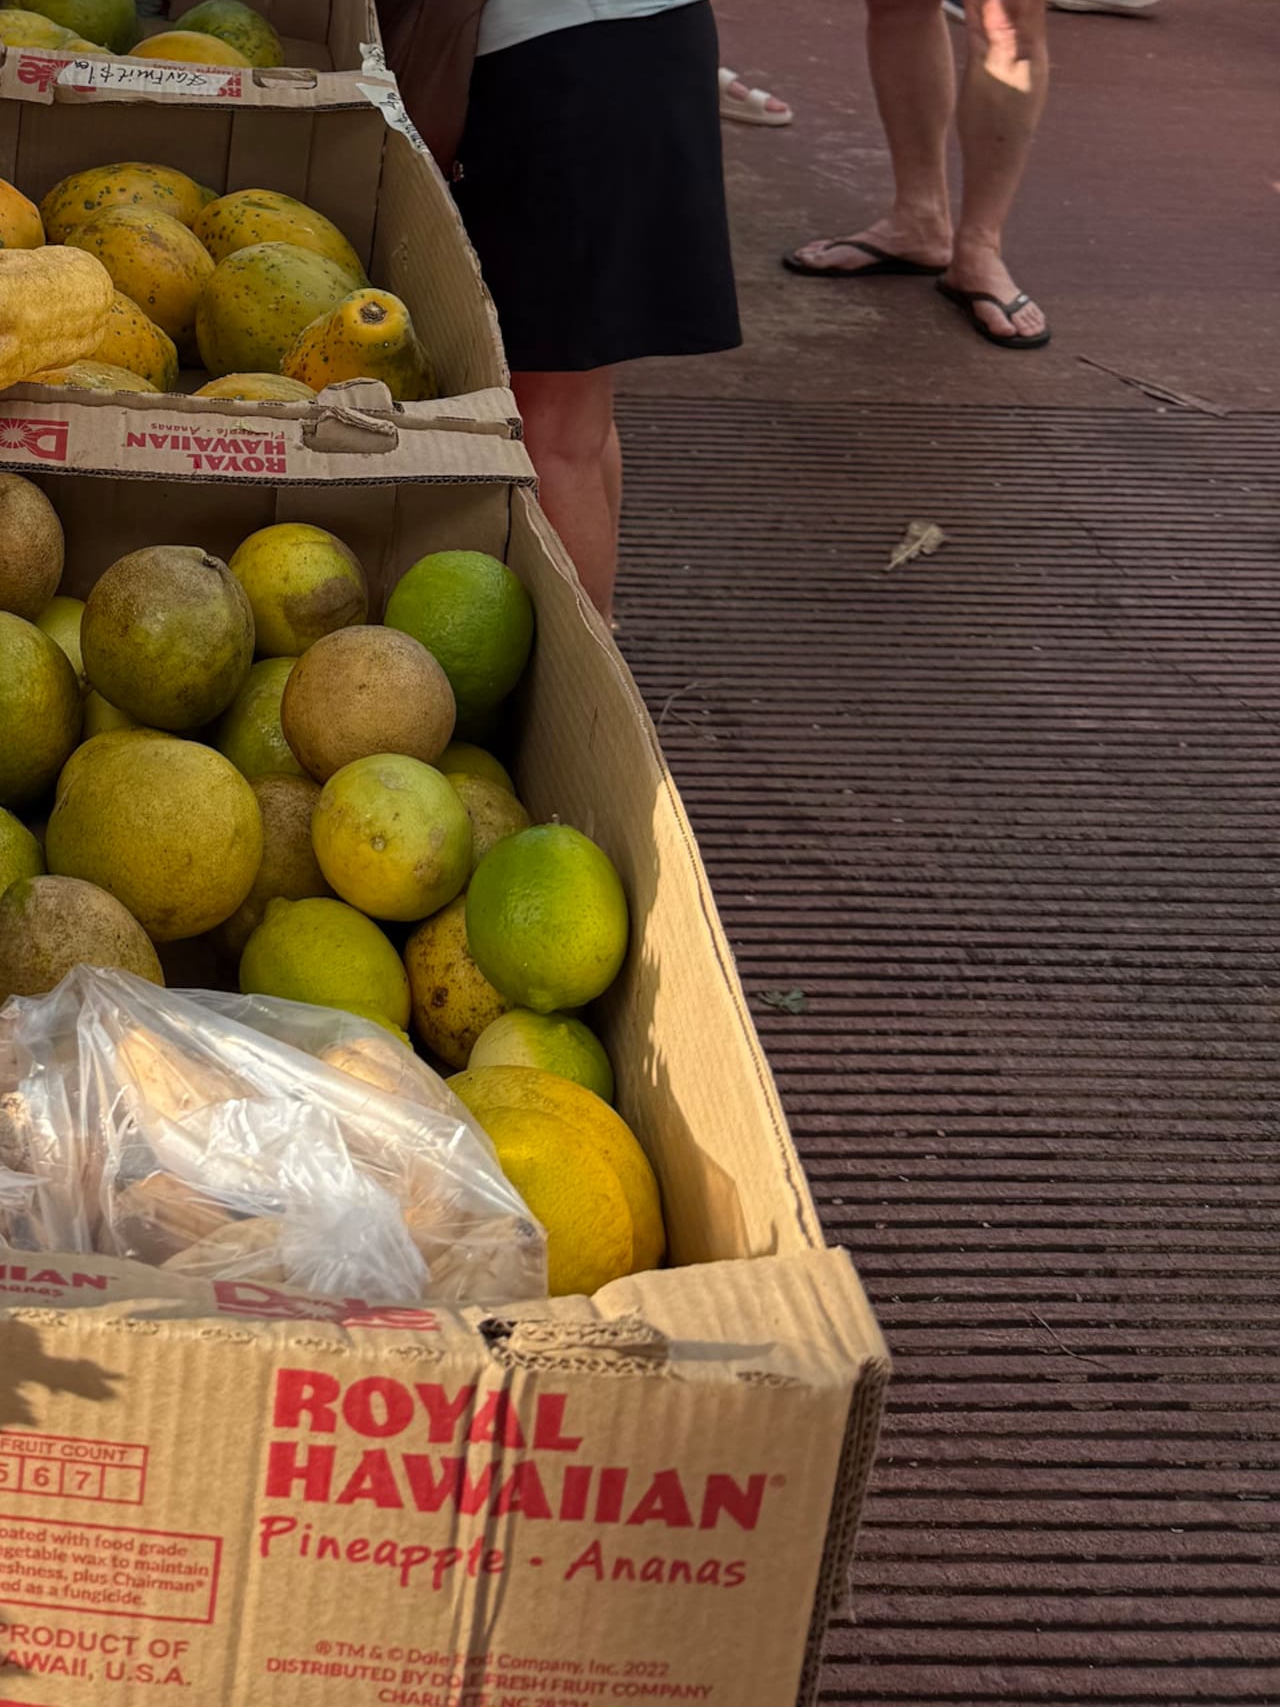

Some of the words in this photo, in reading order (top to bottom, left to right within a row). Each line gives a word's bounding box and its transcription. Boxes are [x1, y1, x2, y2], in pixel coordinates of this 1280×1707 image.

[151, 422, 201, 436] Ananas
[126, 431, 288, 455] HAWAIIAN
[186, 453, 288, 474] ROYAL
[272, 1367, 584, 1453] ROYAL
[0, 1437, 56, 1455] FRUIT
[60, 1444, 128, 1463] COUNT
[33, 1466, 50, 1487] 6
[74, 1470, 92, 1491] 7
[51, 1531, 89, 1548] with
[94, 1534, 135, 1551] food
[138, 1540, 188, 1558] grade
[258, 1514, 505, 1591] Pineapple
[564, 1539, 747, 1590] Ananas
[72, 1552, 106, 1566] wax
[111, 1555, 130, 1569] to
[134, 1559, 210, 1577] maintain
[73, 1567, 108, 1586] plus
[25, 1583, 44, 1595] as
[48, 1586, 58, 1596] a
[62, 1585, 146, 1606] fungicide.
[148, 1638, 190, 1660] OF
[336, 1641, 365, 1658] TM
[369, 1645, 383, 1661] &
[408, 1648, 450, 1665] Dole
[497, 1652, 585, 1676] Company,
[589, 1658, 618, 1677] Inc.
[105, 1659, 193, 1687] U.S.A.
[266, 1657, 397, 1683] DISTRIBUTED
[401, 1668, 430, 1685] BY
[484, 1673, 546, 1692] FRESH
[551, 1676, 608, 1695] FRUIT
[611, 1681, 714, 1700] COMPANY
